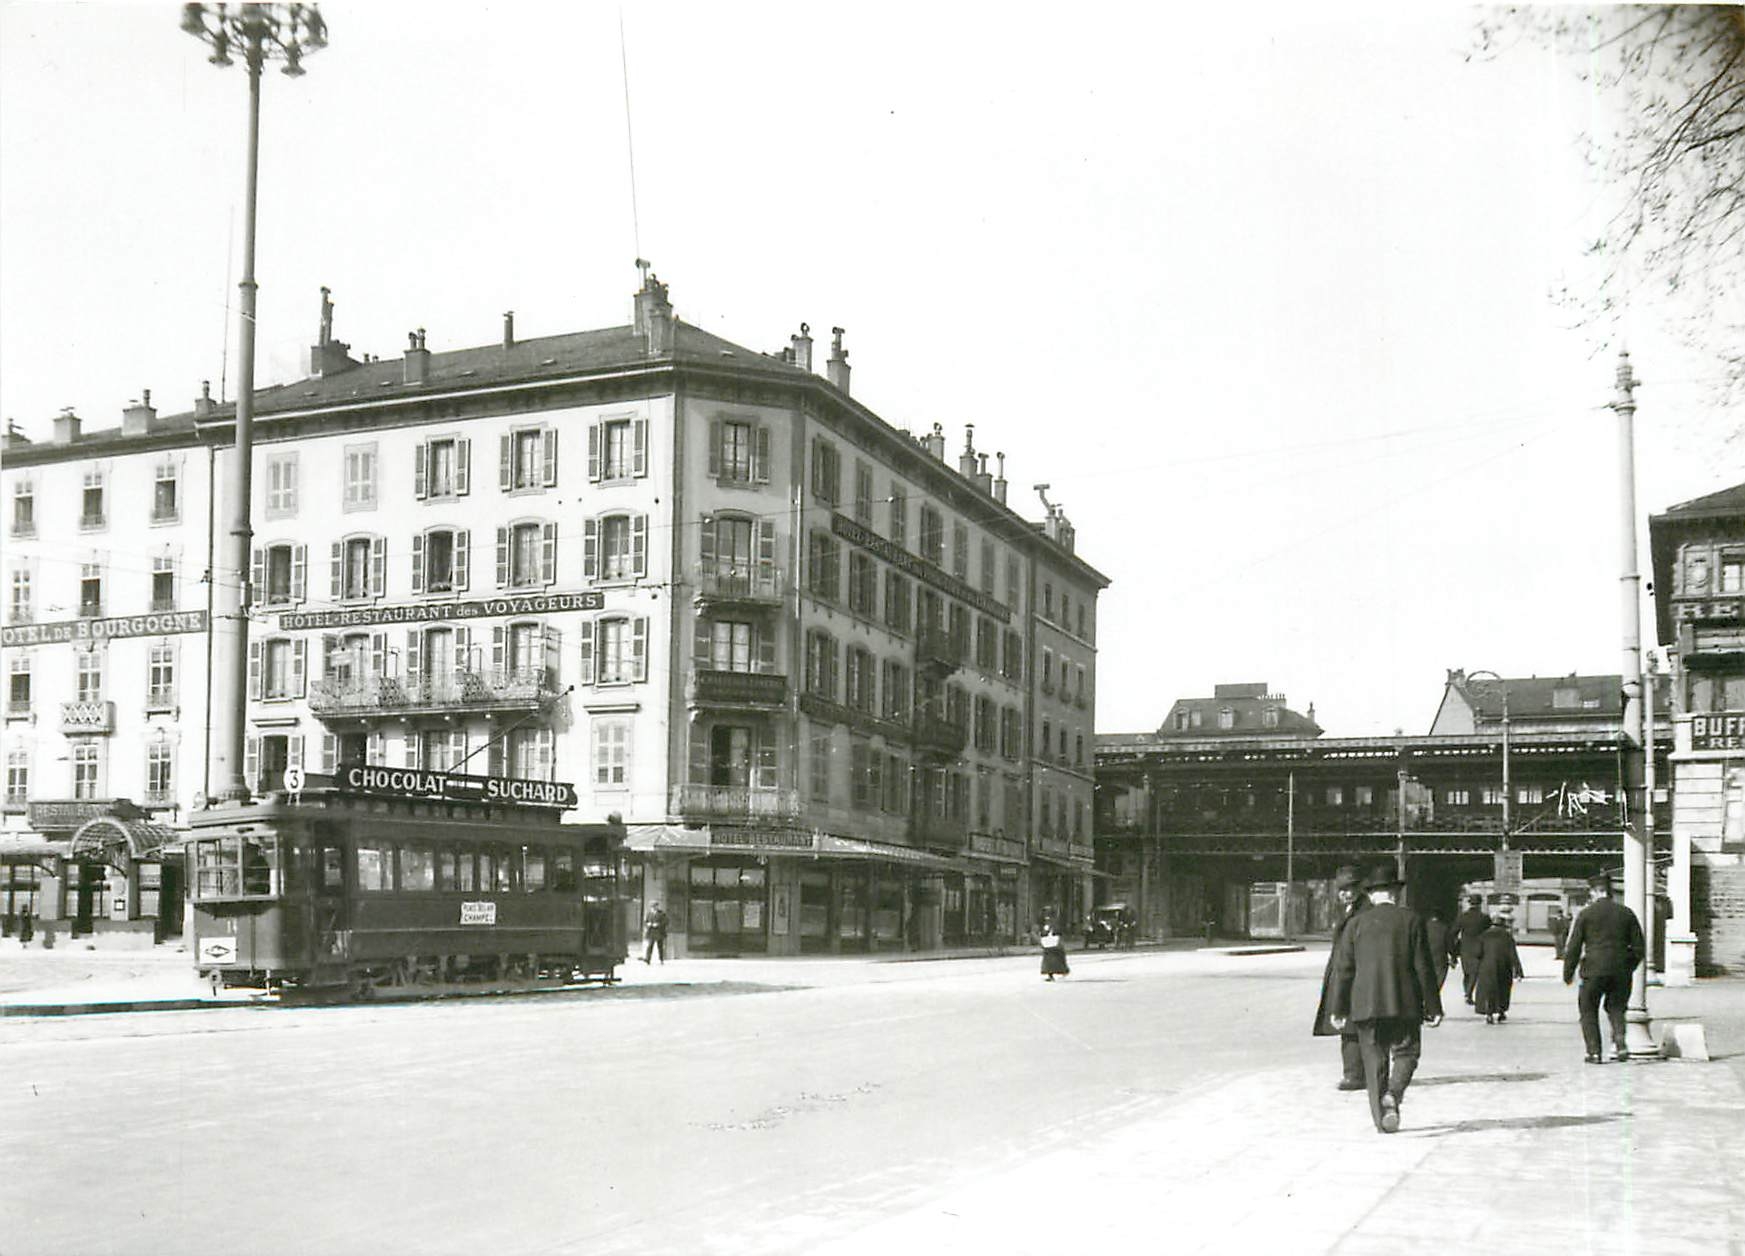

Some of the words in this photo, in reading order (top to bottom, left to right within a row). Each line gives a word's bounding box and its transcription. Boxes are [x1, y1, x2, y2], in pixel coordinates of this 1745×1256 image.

[456, 605, 478, 617] des
[484, 595, 597, 615] VOYAGEURS
[79, 612, 201, 638] BOURGOGNE
[289, 769, 299, 788] 3
[348, 768, 447, 793] CHOCOLAT
[487, 779, 568, 802] SUCHARD
